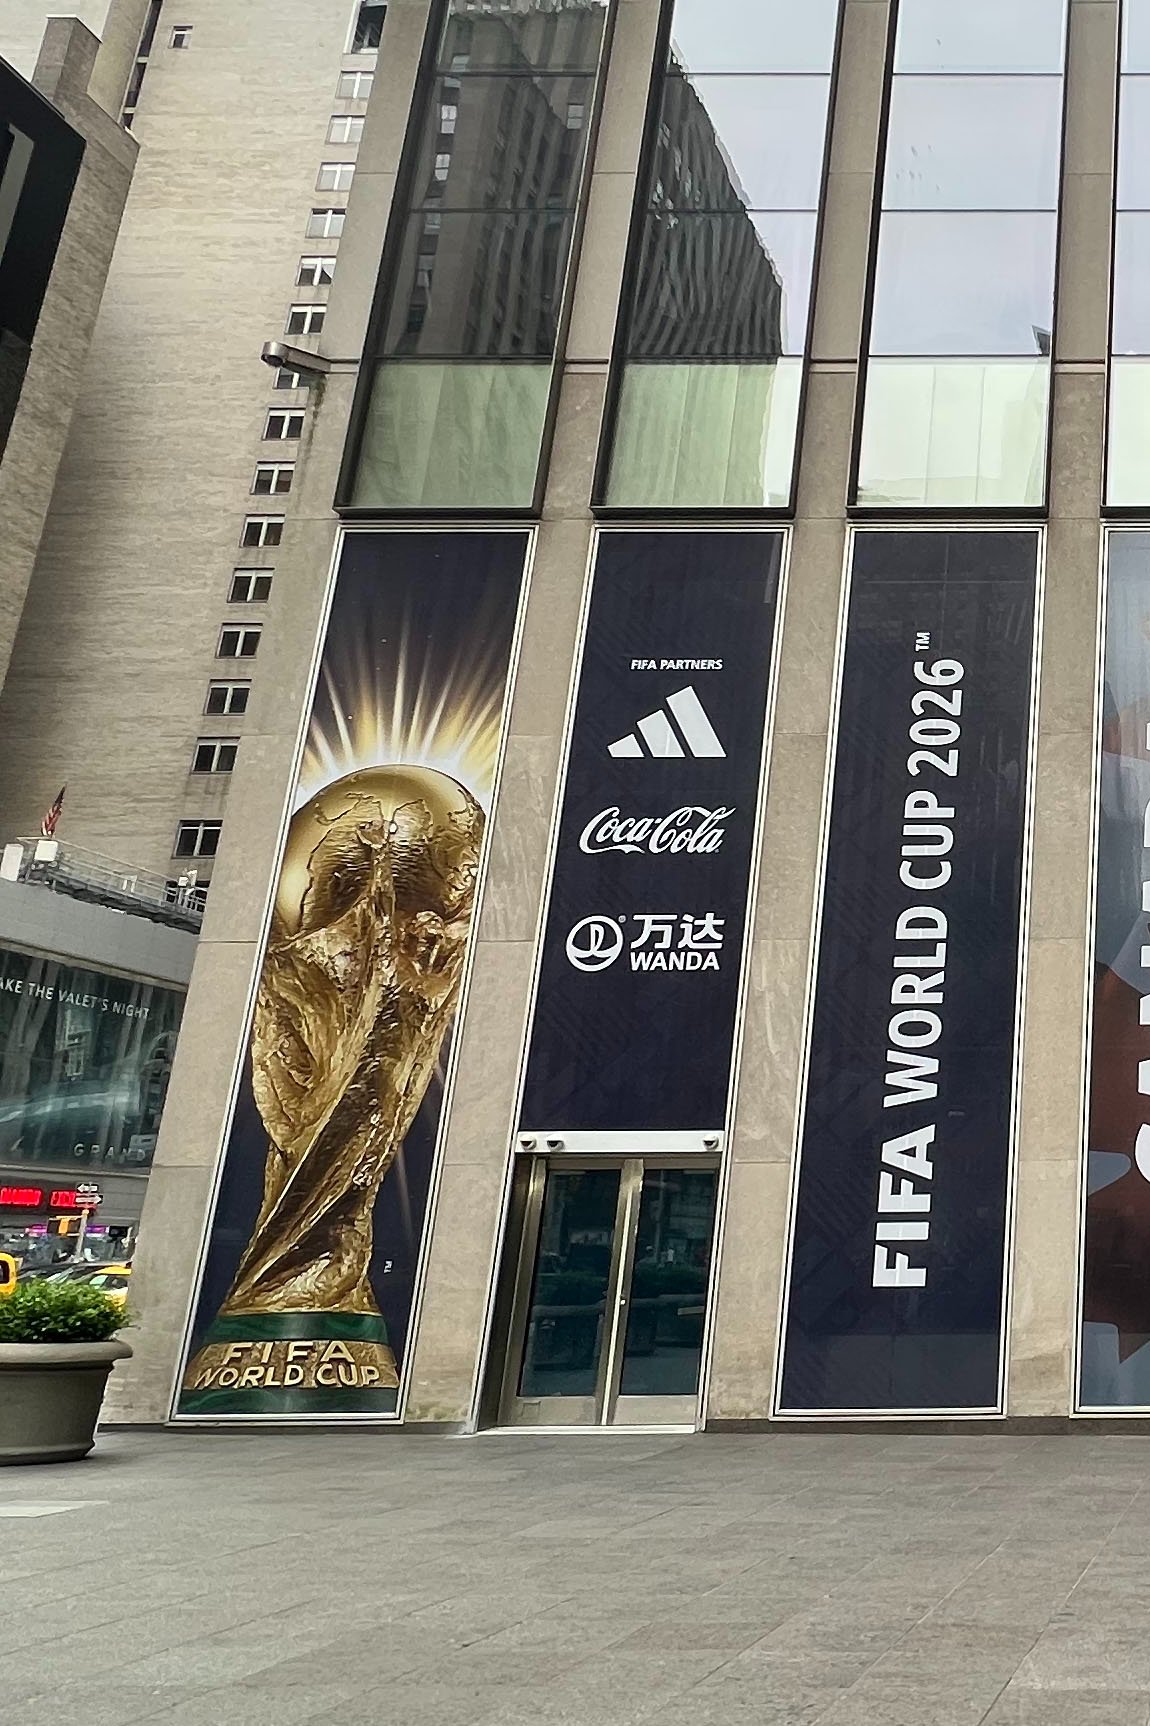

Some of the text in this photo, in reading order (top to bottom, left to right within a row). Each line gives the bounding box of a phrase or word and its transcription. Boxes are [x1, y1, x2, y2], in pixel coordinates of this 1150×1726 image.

[630, 659, 723, 670] FIFA PARTNERS
[579, 806, 737, 854] Coca-Cola
[899, 789, 955, 890] CUP
[630, 912, 725, 949] 万达
[630, 951, 720, 971] WANDA
[28, 982, 54, 1000] THE
[112, 1001, 150, 1020] NIGHT
[883, 906, 948, 1108] WORLD
[872, 1124, 936, 1288] FIFA
[221, 1339, 355, 1364] FIFA
[194, 1363, 381, 1389] WORLD CUP
